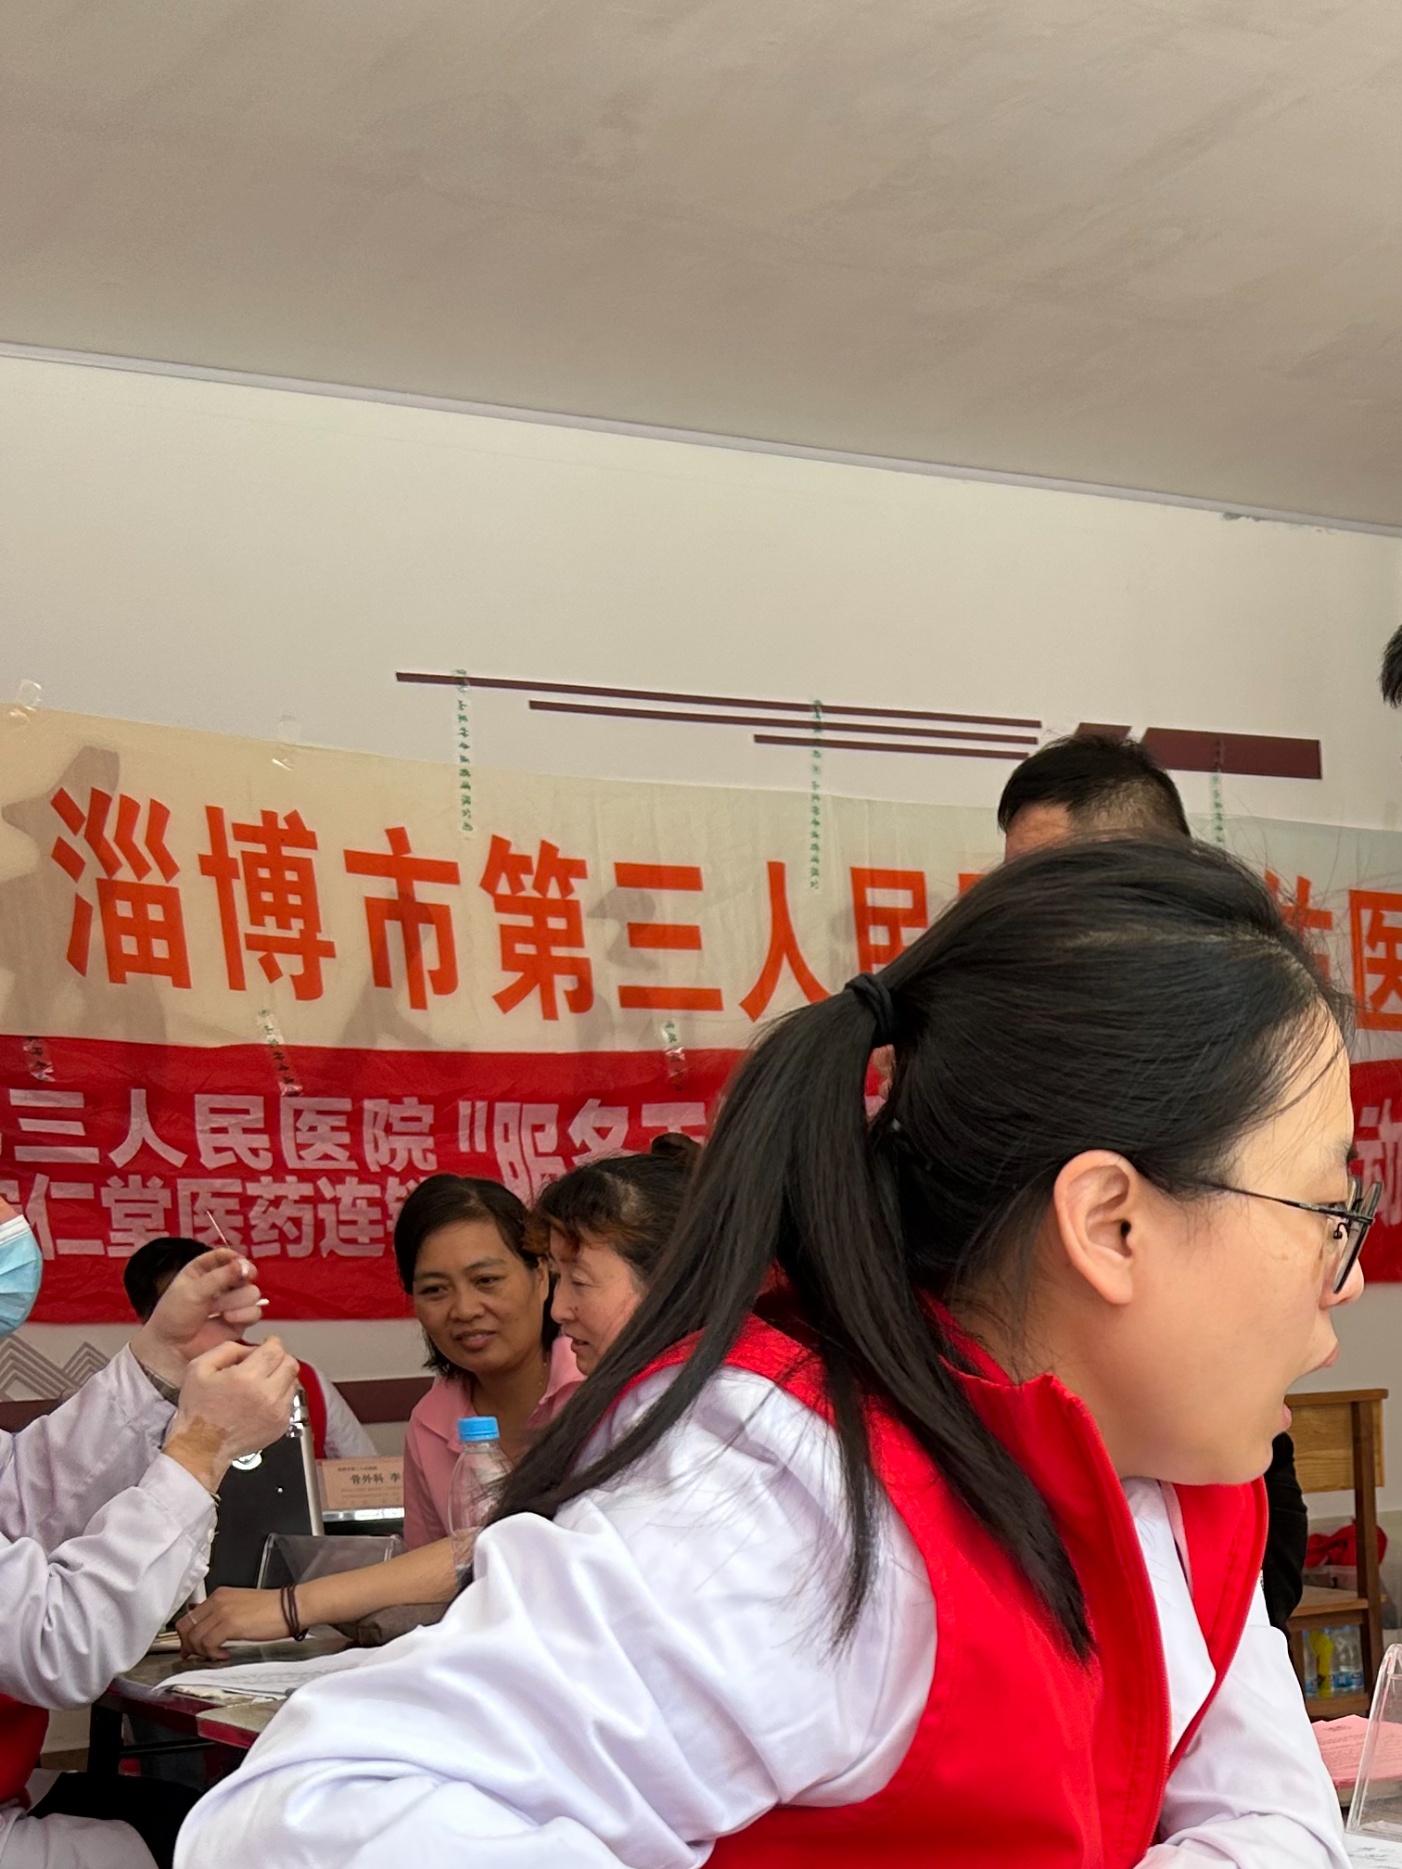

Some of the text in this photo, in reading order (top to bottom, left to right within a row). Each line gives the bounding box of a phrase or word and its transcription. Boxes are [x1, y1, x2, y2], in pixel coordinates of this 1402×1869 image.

[50, 787, 986, 1022] 淄博市第三人民
[0, 1173, 418, 1261] 仁堂医药连
